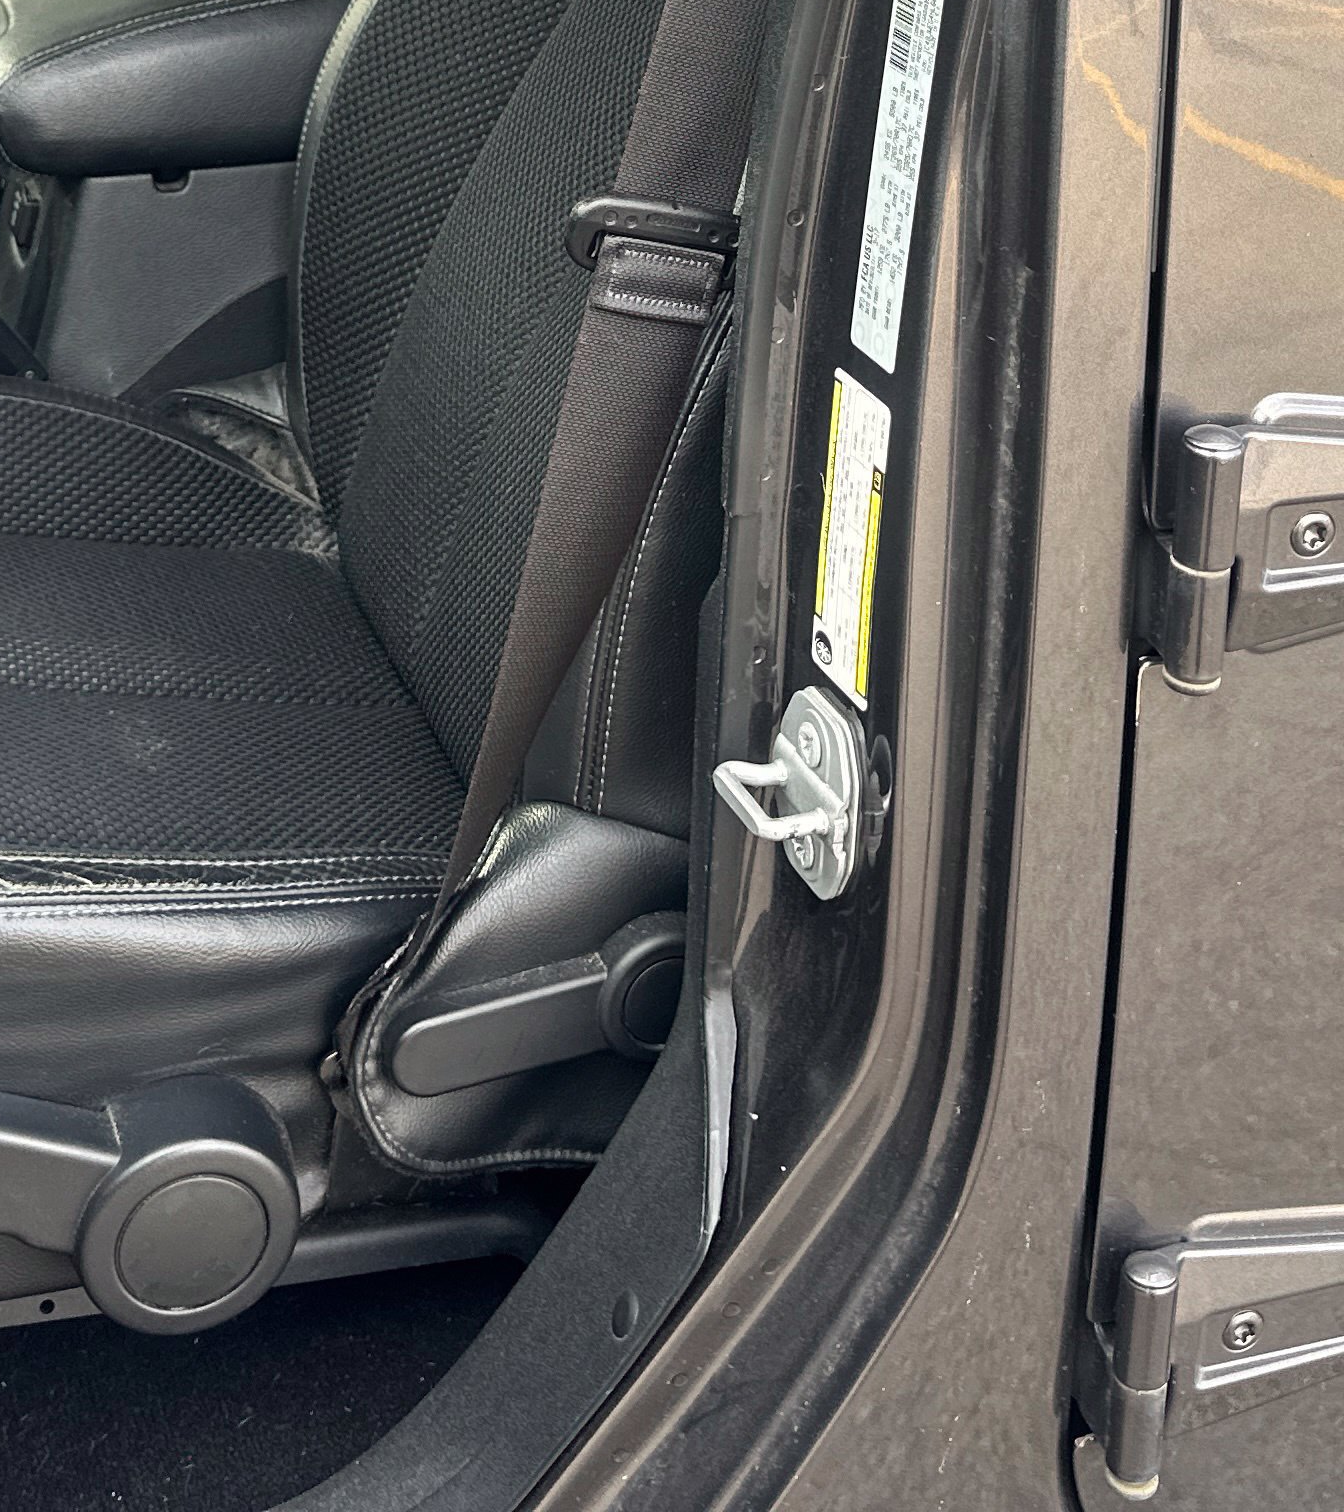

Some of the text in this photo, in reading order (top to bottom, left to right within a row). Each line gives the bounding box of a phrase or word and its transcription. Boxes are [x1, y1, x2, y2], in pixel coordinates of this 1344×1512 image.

[865, 223, 873, 244] LLC
[863, 244, 871, 261] US
[860, 260, 869, 282] FCA
